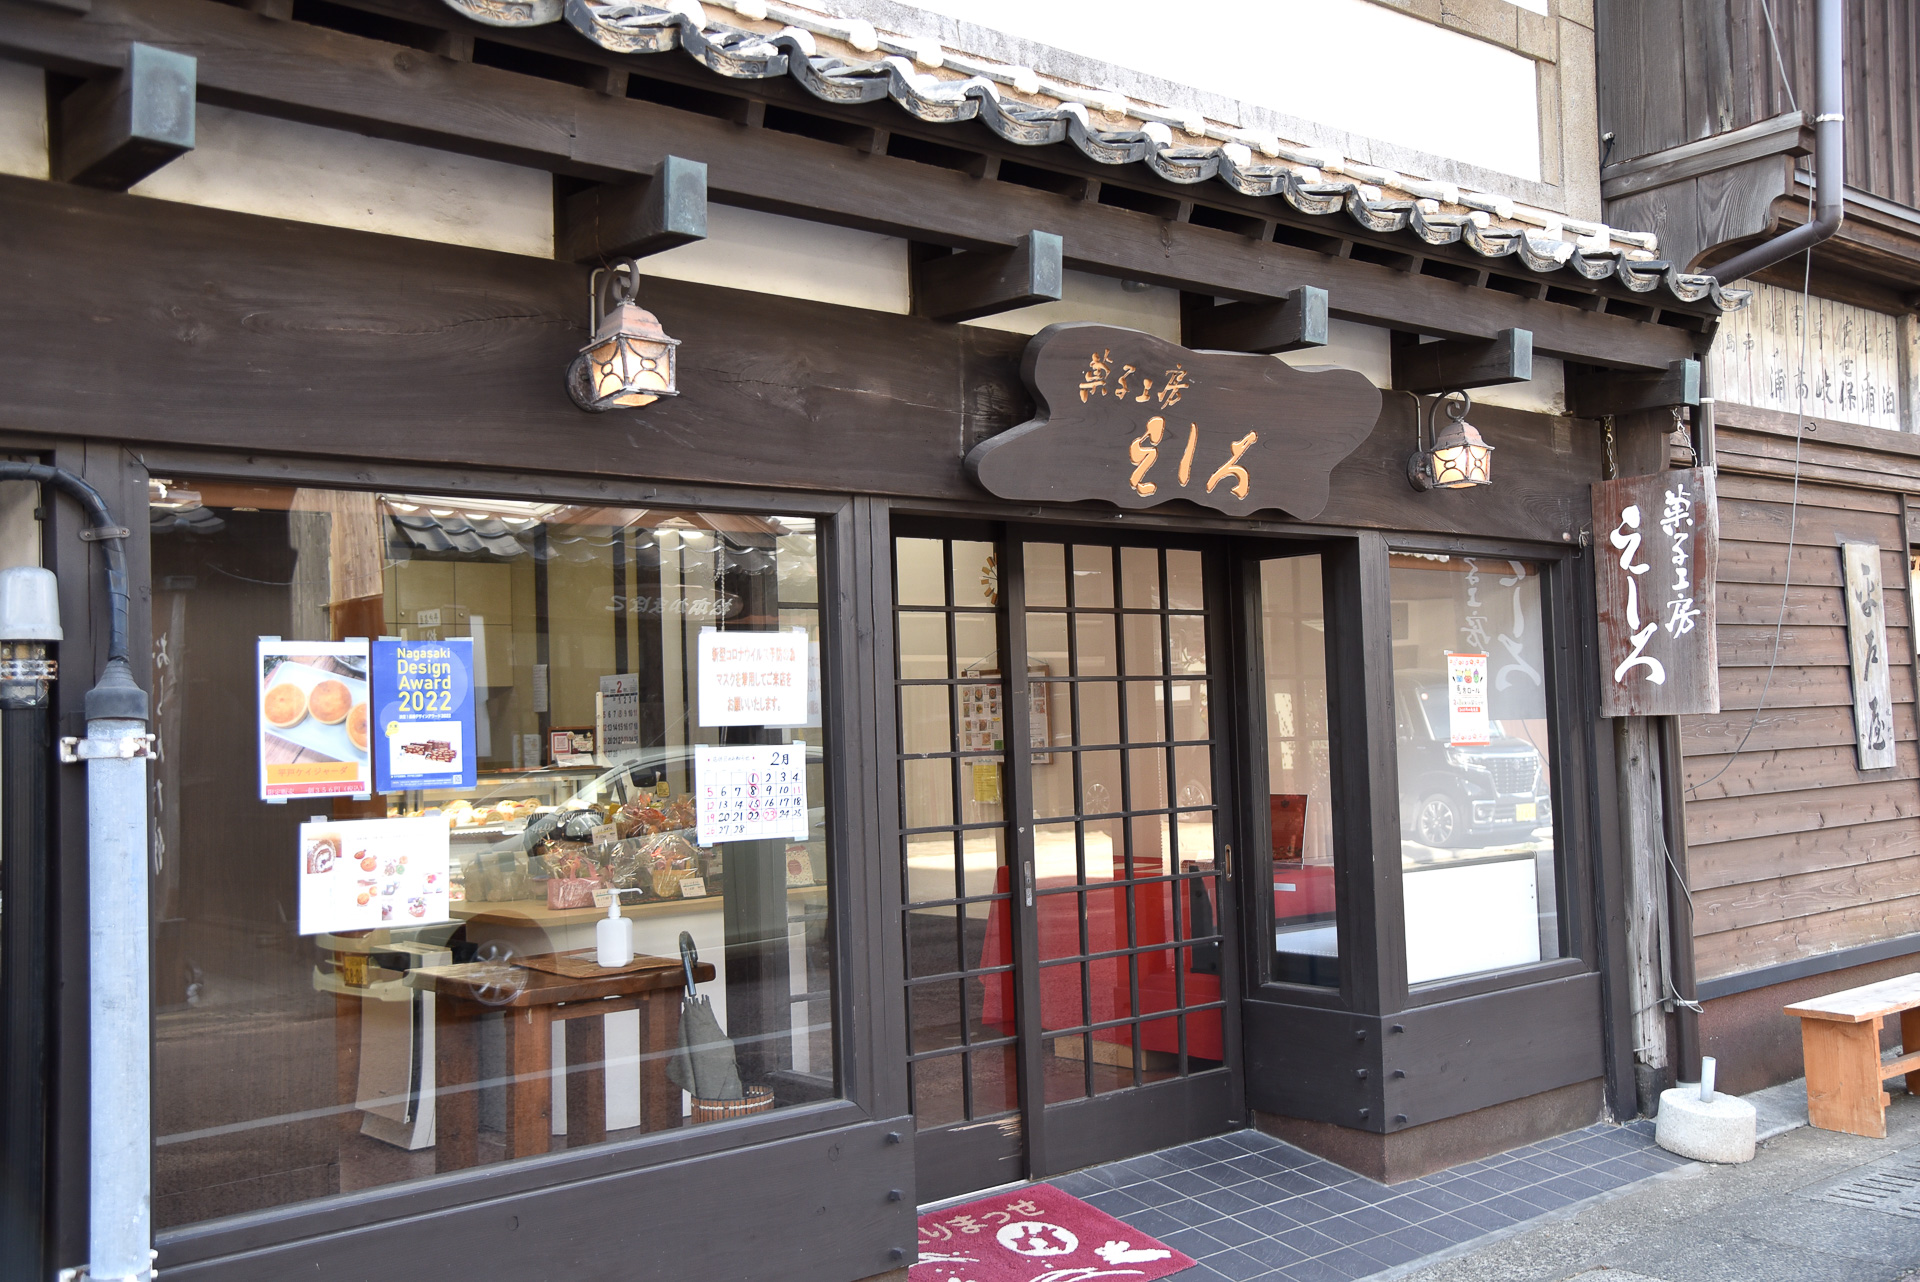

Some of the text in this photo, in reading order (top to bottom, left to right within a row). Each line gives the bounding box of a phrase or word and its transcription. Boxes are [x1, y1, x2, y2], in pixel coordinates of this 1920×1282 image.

[1078, 348, 1190, 410] 菓子工房
[1129, 415, 1259, 500] えしろ
[1659, 483, 1701, 640] 菓子工房
[1610, 504, 1666, 686] えしろ
[397, 648, 450, 660] Nagasaki
[397, 660, 451, 678] Design
[398, 675, 451, 690] Award
[716, 672, 792, 687] マスクを着用してご来店を
[398, 691, 452, 712] 2022
[727, 696, 781, 712] お願いいたします。
[770, 752, 789, 766] 2月
[765, 772, 771, 783] 2
[780, 772, 786, 782] 3
[792, 773, 800, 783] 4
[707, 787, 713, 797] 5
[721, 786, 727, 797] 6
[734, 787, 741, 797] 7
[750, 786, 757, 796] 8
[766, 785, 772, 796] 9
[779, 785, 789, 795] 10
[707, 797, 802, 810] 12 13 14 15 16 17 18
[706, 814, 715, 823] 19
[718, 812, 730, 823] 20
[732, 812, 743, 822] 21
[748, 811, 759, 821] 22
[778, 809, 790, 819] 24
[718, 825, 729, 835] 27
[733, 825, 745, 834] 28
